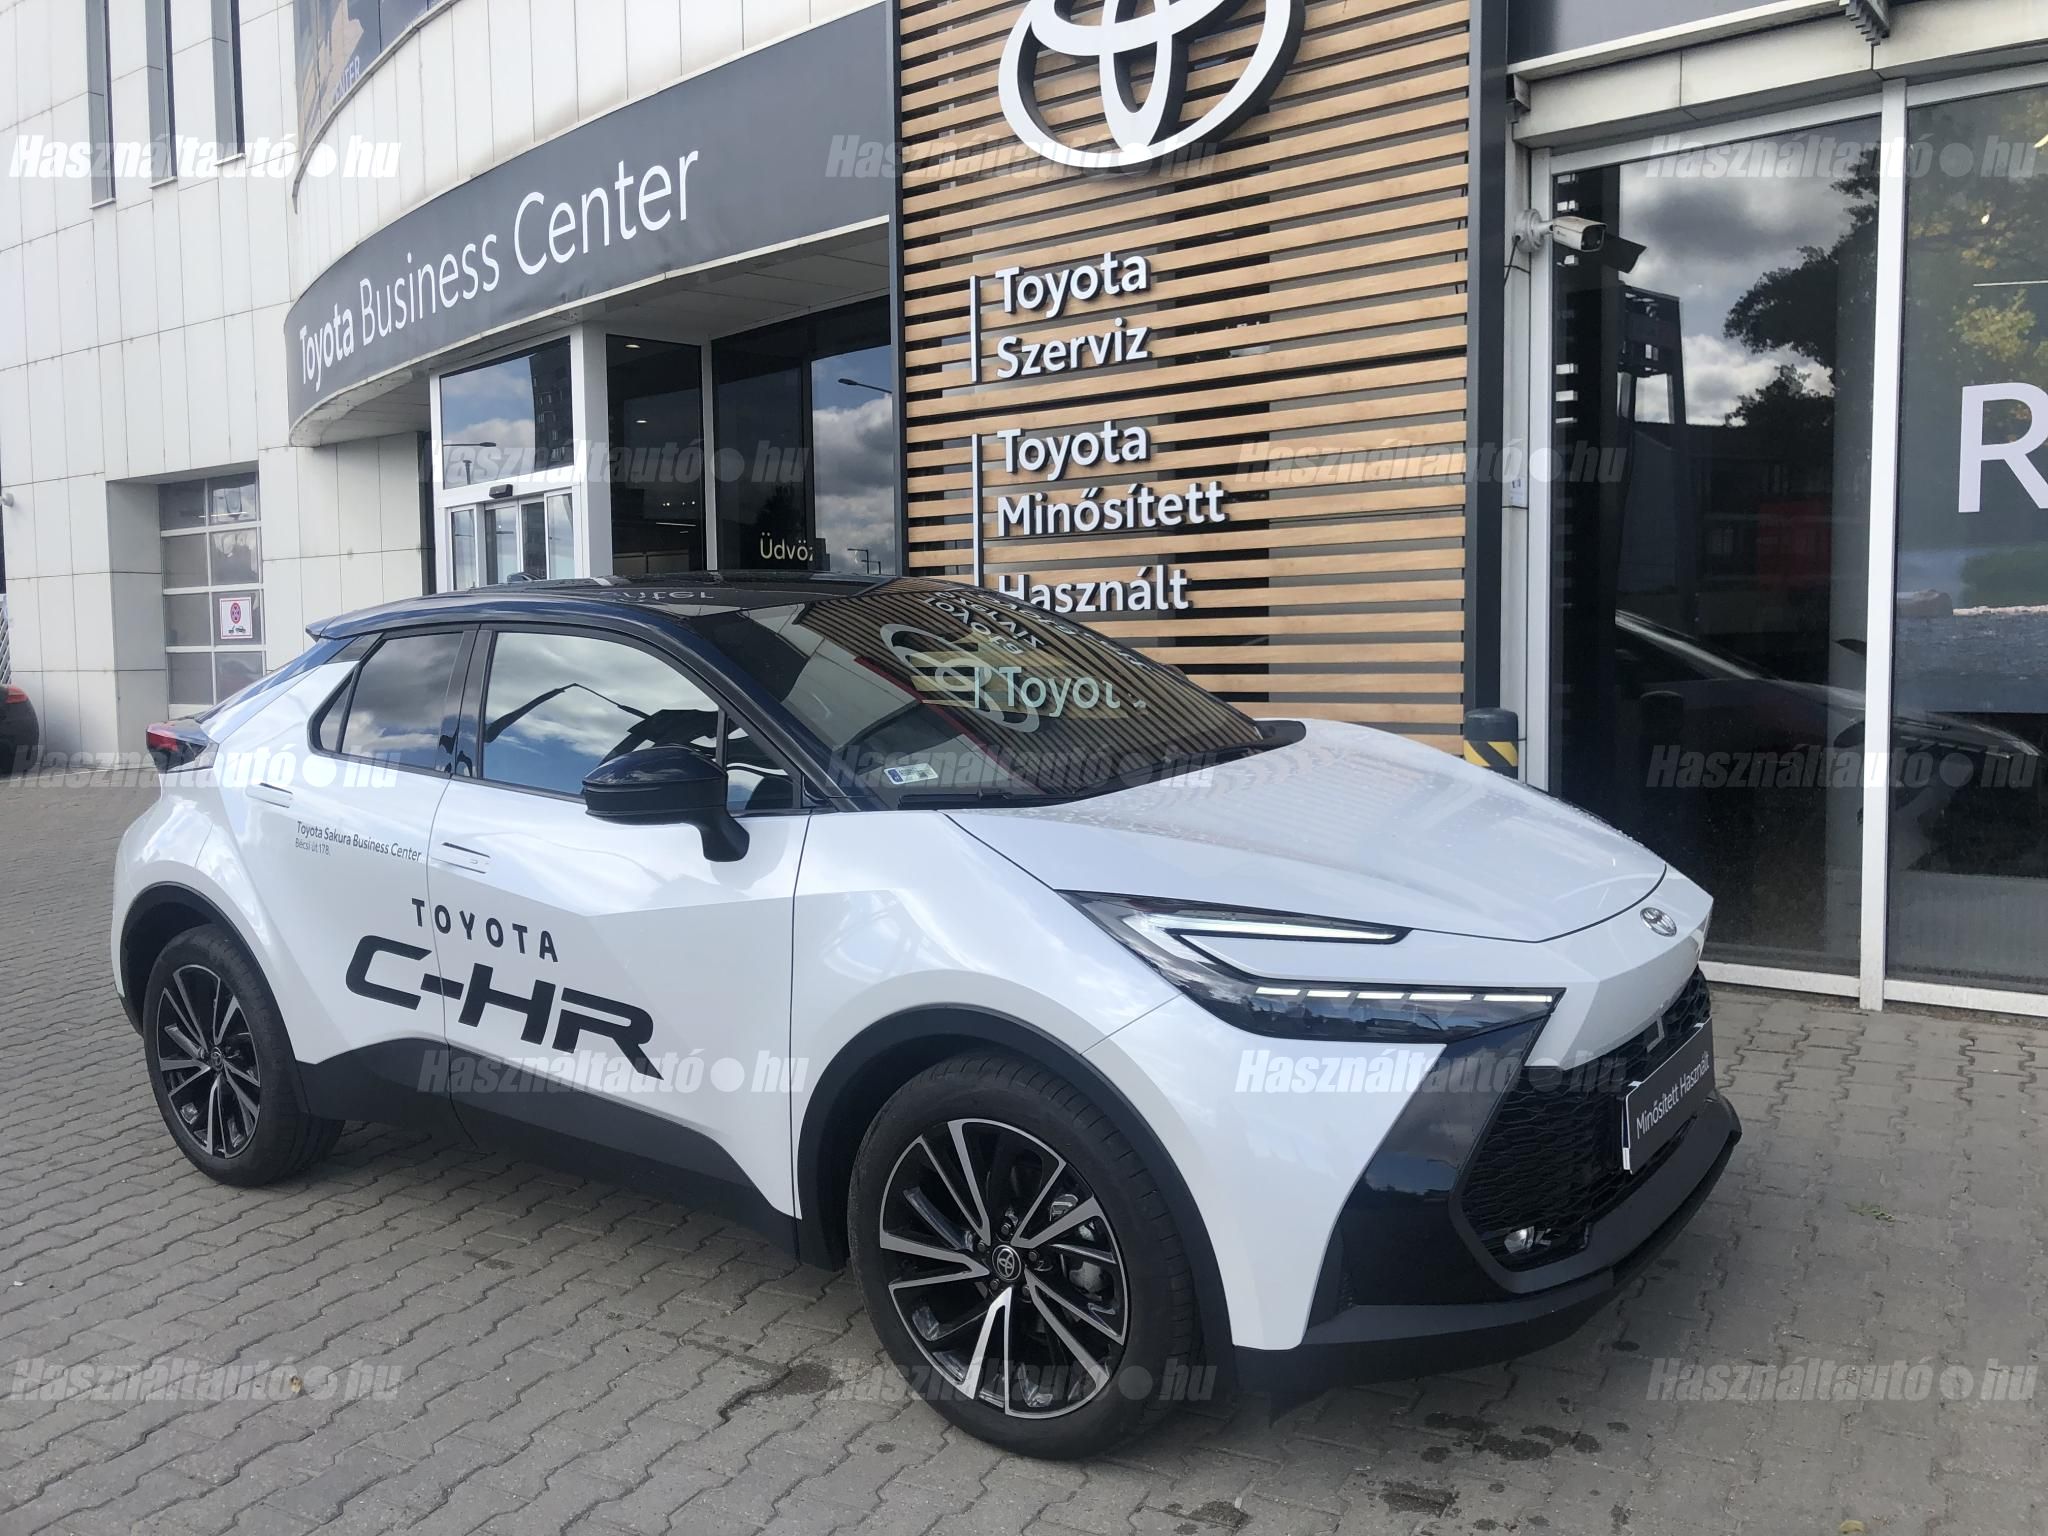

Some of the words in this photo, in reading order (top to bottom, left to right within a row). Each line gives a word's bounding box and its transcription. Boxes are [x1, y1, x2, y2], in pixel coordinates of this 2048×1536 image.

[299, 301, 355, 392] Toyota
[359, 233, 501, 346] Business
[513, 150, 700, 276] Center
[995, 251, 1149, 318] Toyota
[996, 317, 1150, 379] Szerviz
[996, 420, 1149, 482] Toyota
[997, 480, 1226, 538] Minősített
[997, 564, 1190, 614] Használt
[296, 820, 324, 839] Toyota
[323, 827, 352, 846] Sakura
[352, 833, 390, 855] Business
[390, 842, 422, 861] Center
[411, 897, 559, 963] TOYOTA
[345, 934, 665, 1081] C-HR
[1636, 1083, 1680, 1140] Minősített
[1679, 1050, 1710, 1097] Használt
